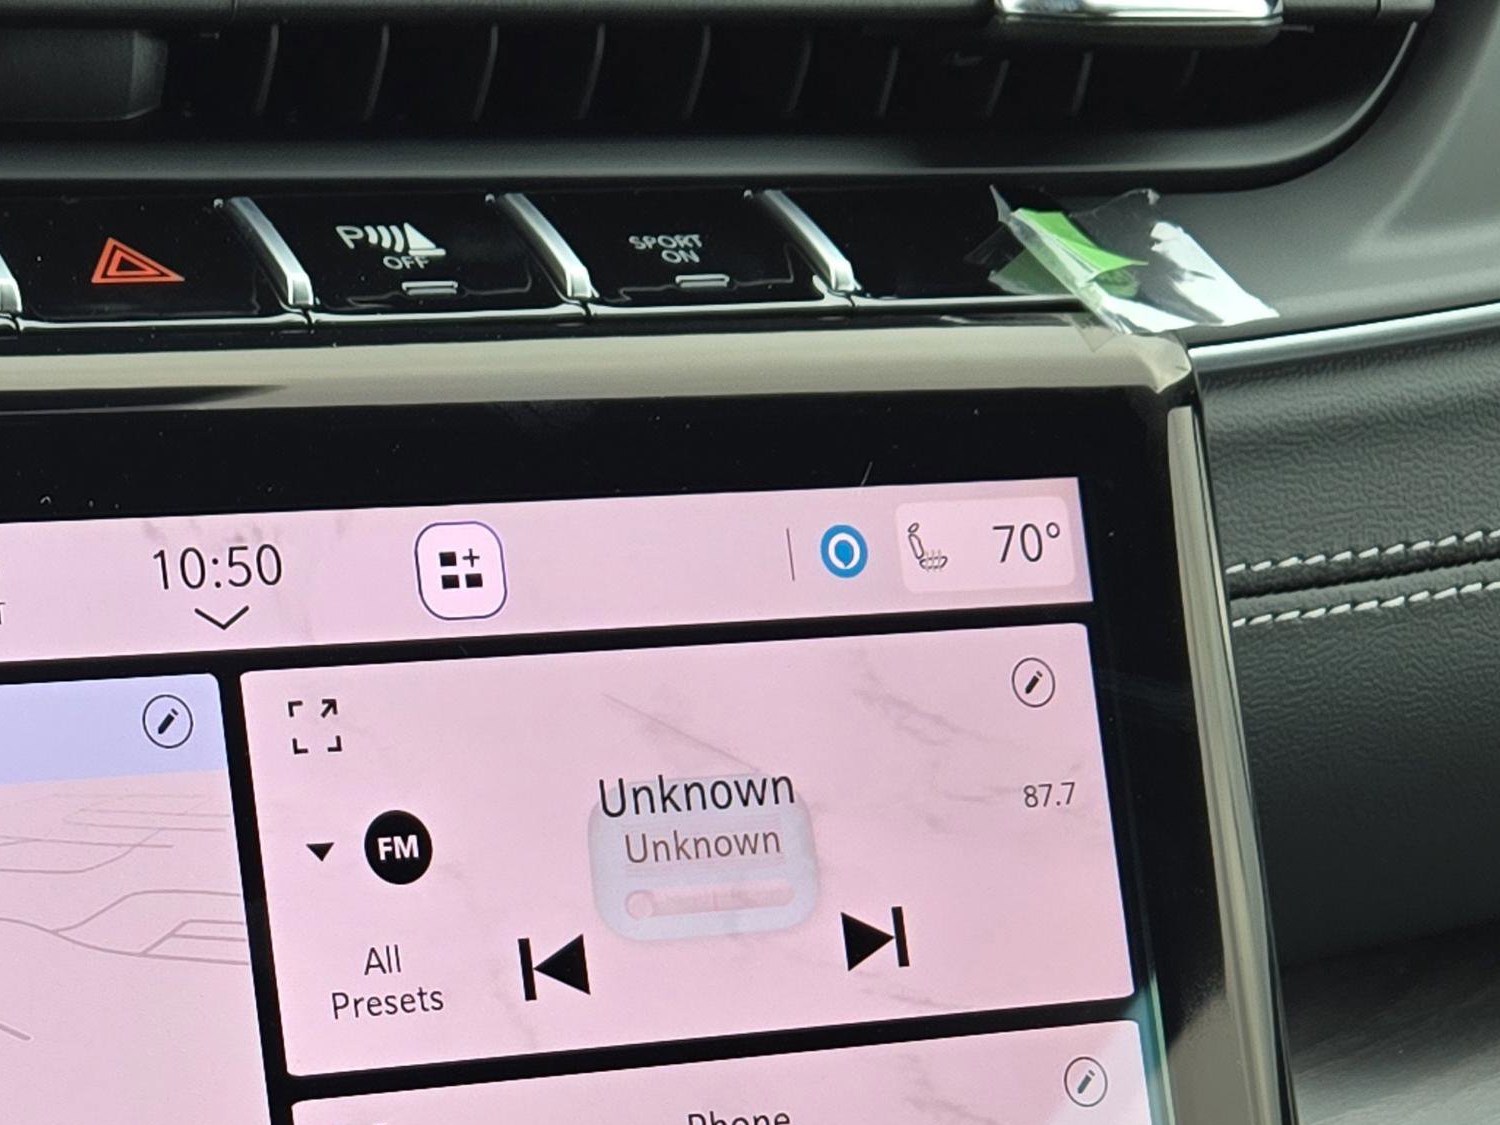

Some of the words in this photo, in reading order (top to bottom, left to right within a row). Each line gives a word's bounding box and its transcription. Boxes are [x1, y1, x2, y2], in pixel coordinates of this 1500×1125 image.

[629, 234, 701, 251] SPORT
[662, 249, 700, 264] ON
[383, 255, 429, 270] OFF
[992, 521, 1060, 564] 70°
[152, 543, 283, 592] 10:50
[599, 774, 796, 818] Unknown
[1023, 781, 1075, 808] 87.7
[377, 834, 419, 861] FM
[625, 829, 781, 864] Unknown
[363, 944, 402, 976] All
[331, 986, 444, 1020] Presets
